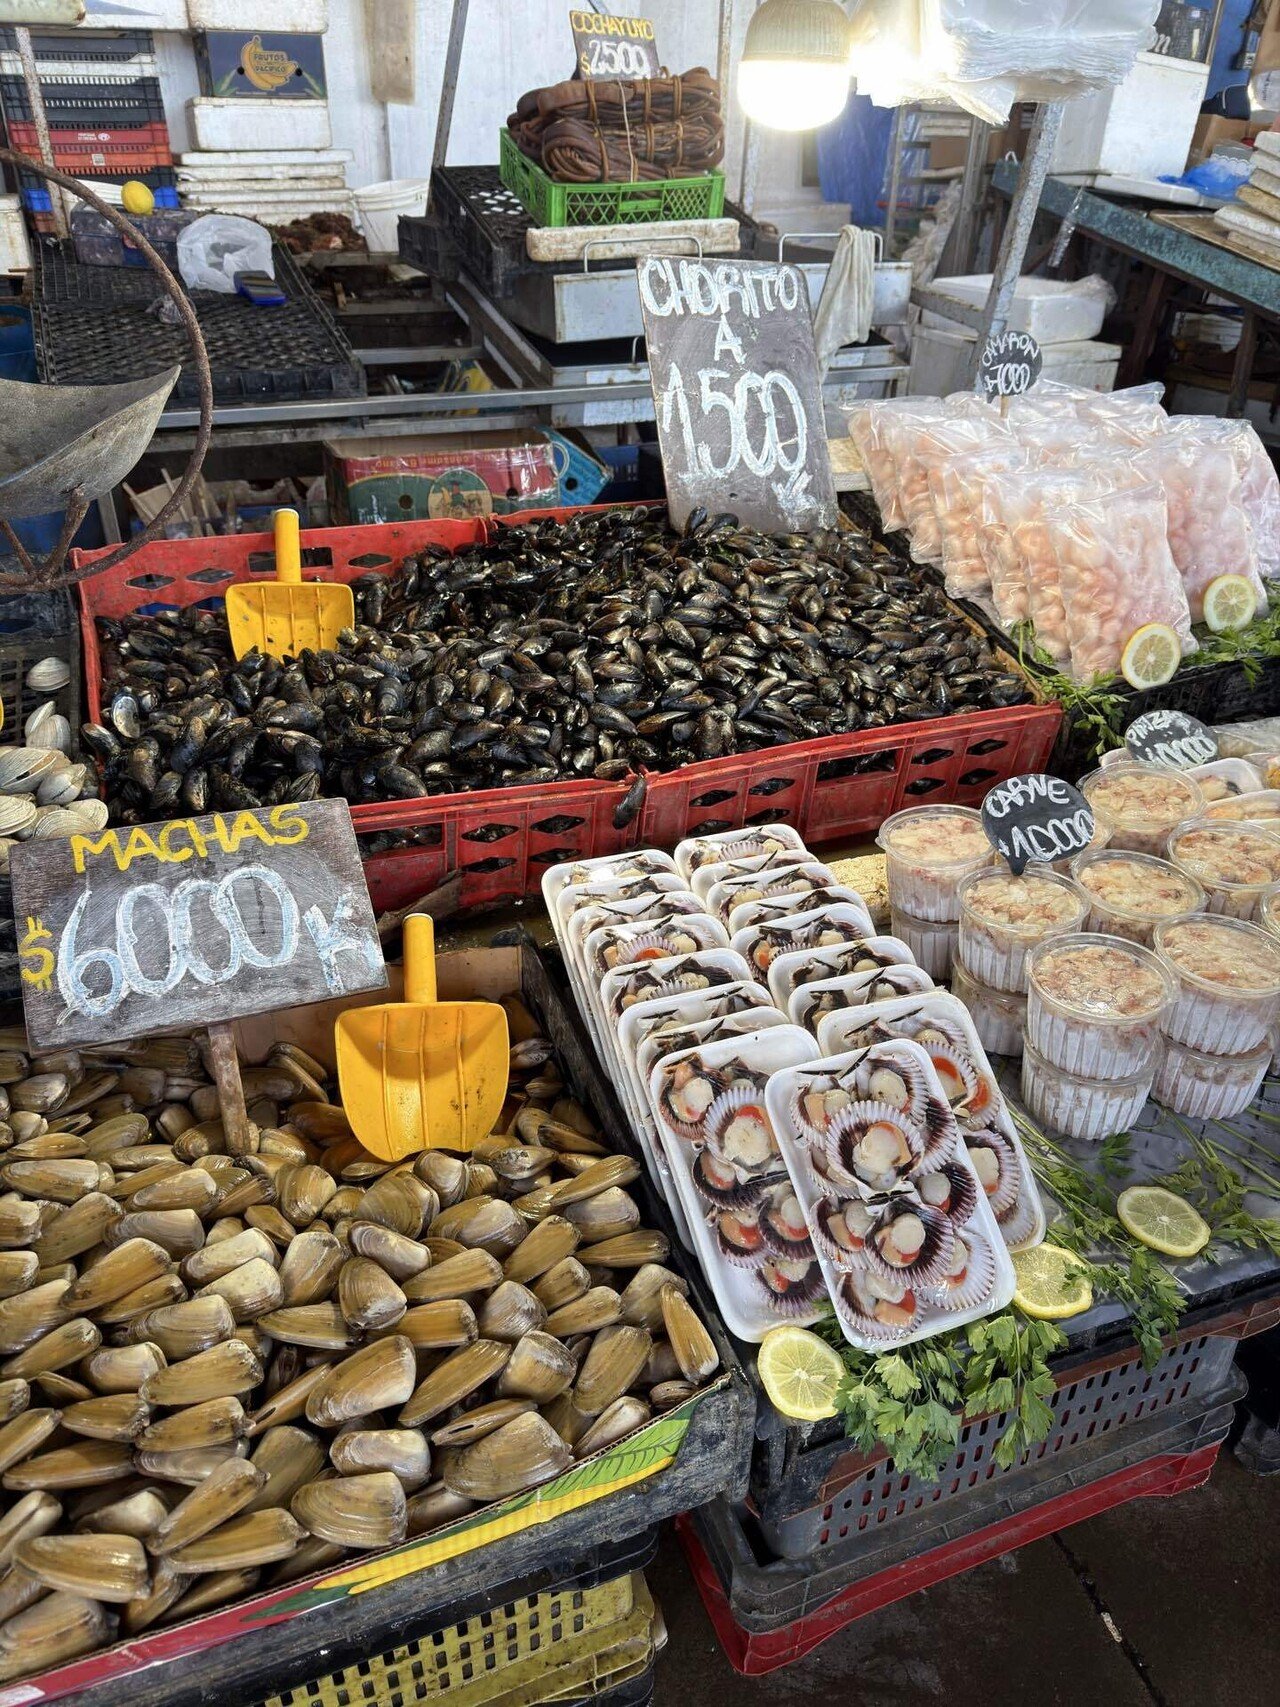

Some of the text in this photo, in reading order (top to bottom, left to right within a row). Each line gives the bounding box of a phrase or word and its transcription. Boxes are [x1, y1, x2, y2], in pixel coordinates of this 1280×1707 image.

[571, 12, 654, 40] COCHAYUYO
[640, 258, 799, 319] CHORITO
[714, 313, 747, 364] A
[661, 362, 808, 484] 1500
[985, 774, 1070, 818] CARNE
[70, 803, 310, 873] MACHAS
